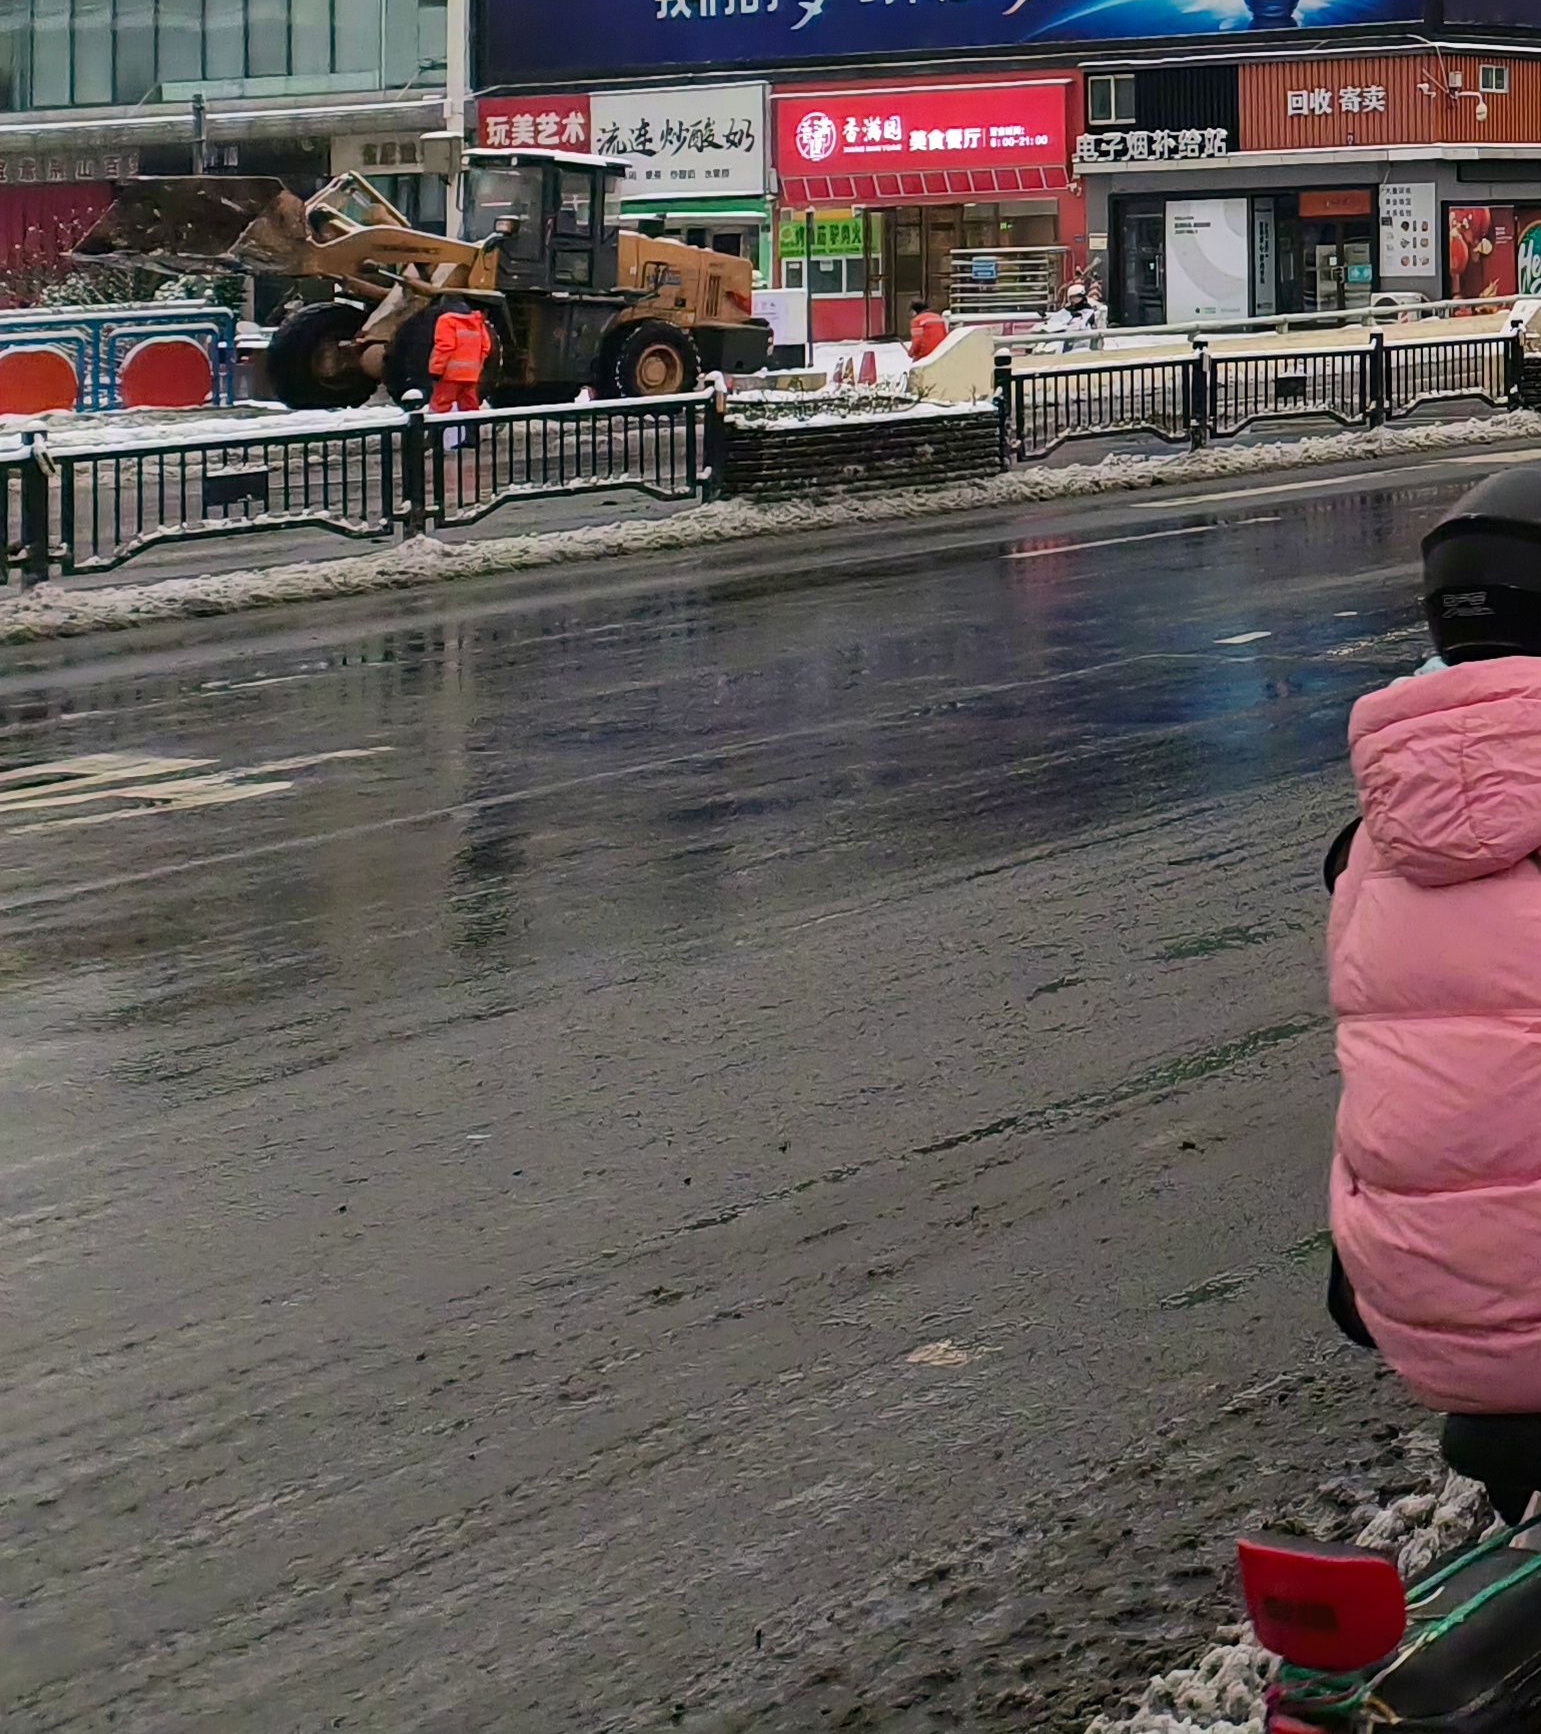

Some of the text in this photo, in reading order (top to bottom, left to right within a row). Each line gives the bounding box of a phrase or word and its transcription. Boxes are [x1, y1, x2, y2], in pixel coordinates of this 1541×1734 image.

[1287, 85, 1387, 116] 回收 寄卖
[486, 110, 586, 146] 玩美艺术
[596, 117, 756, 157] 流连炒酸奶
[1075, 128, 1229, 162] 电子烟补给站
